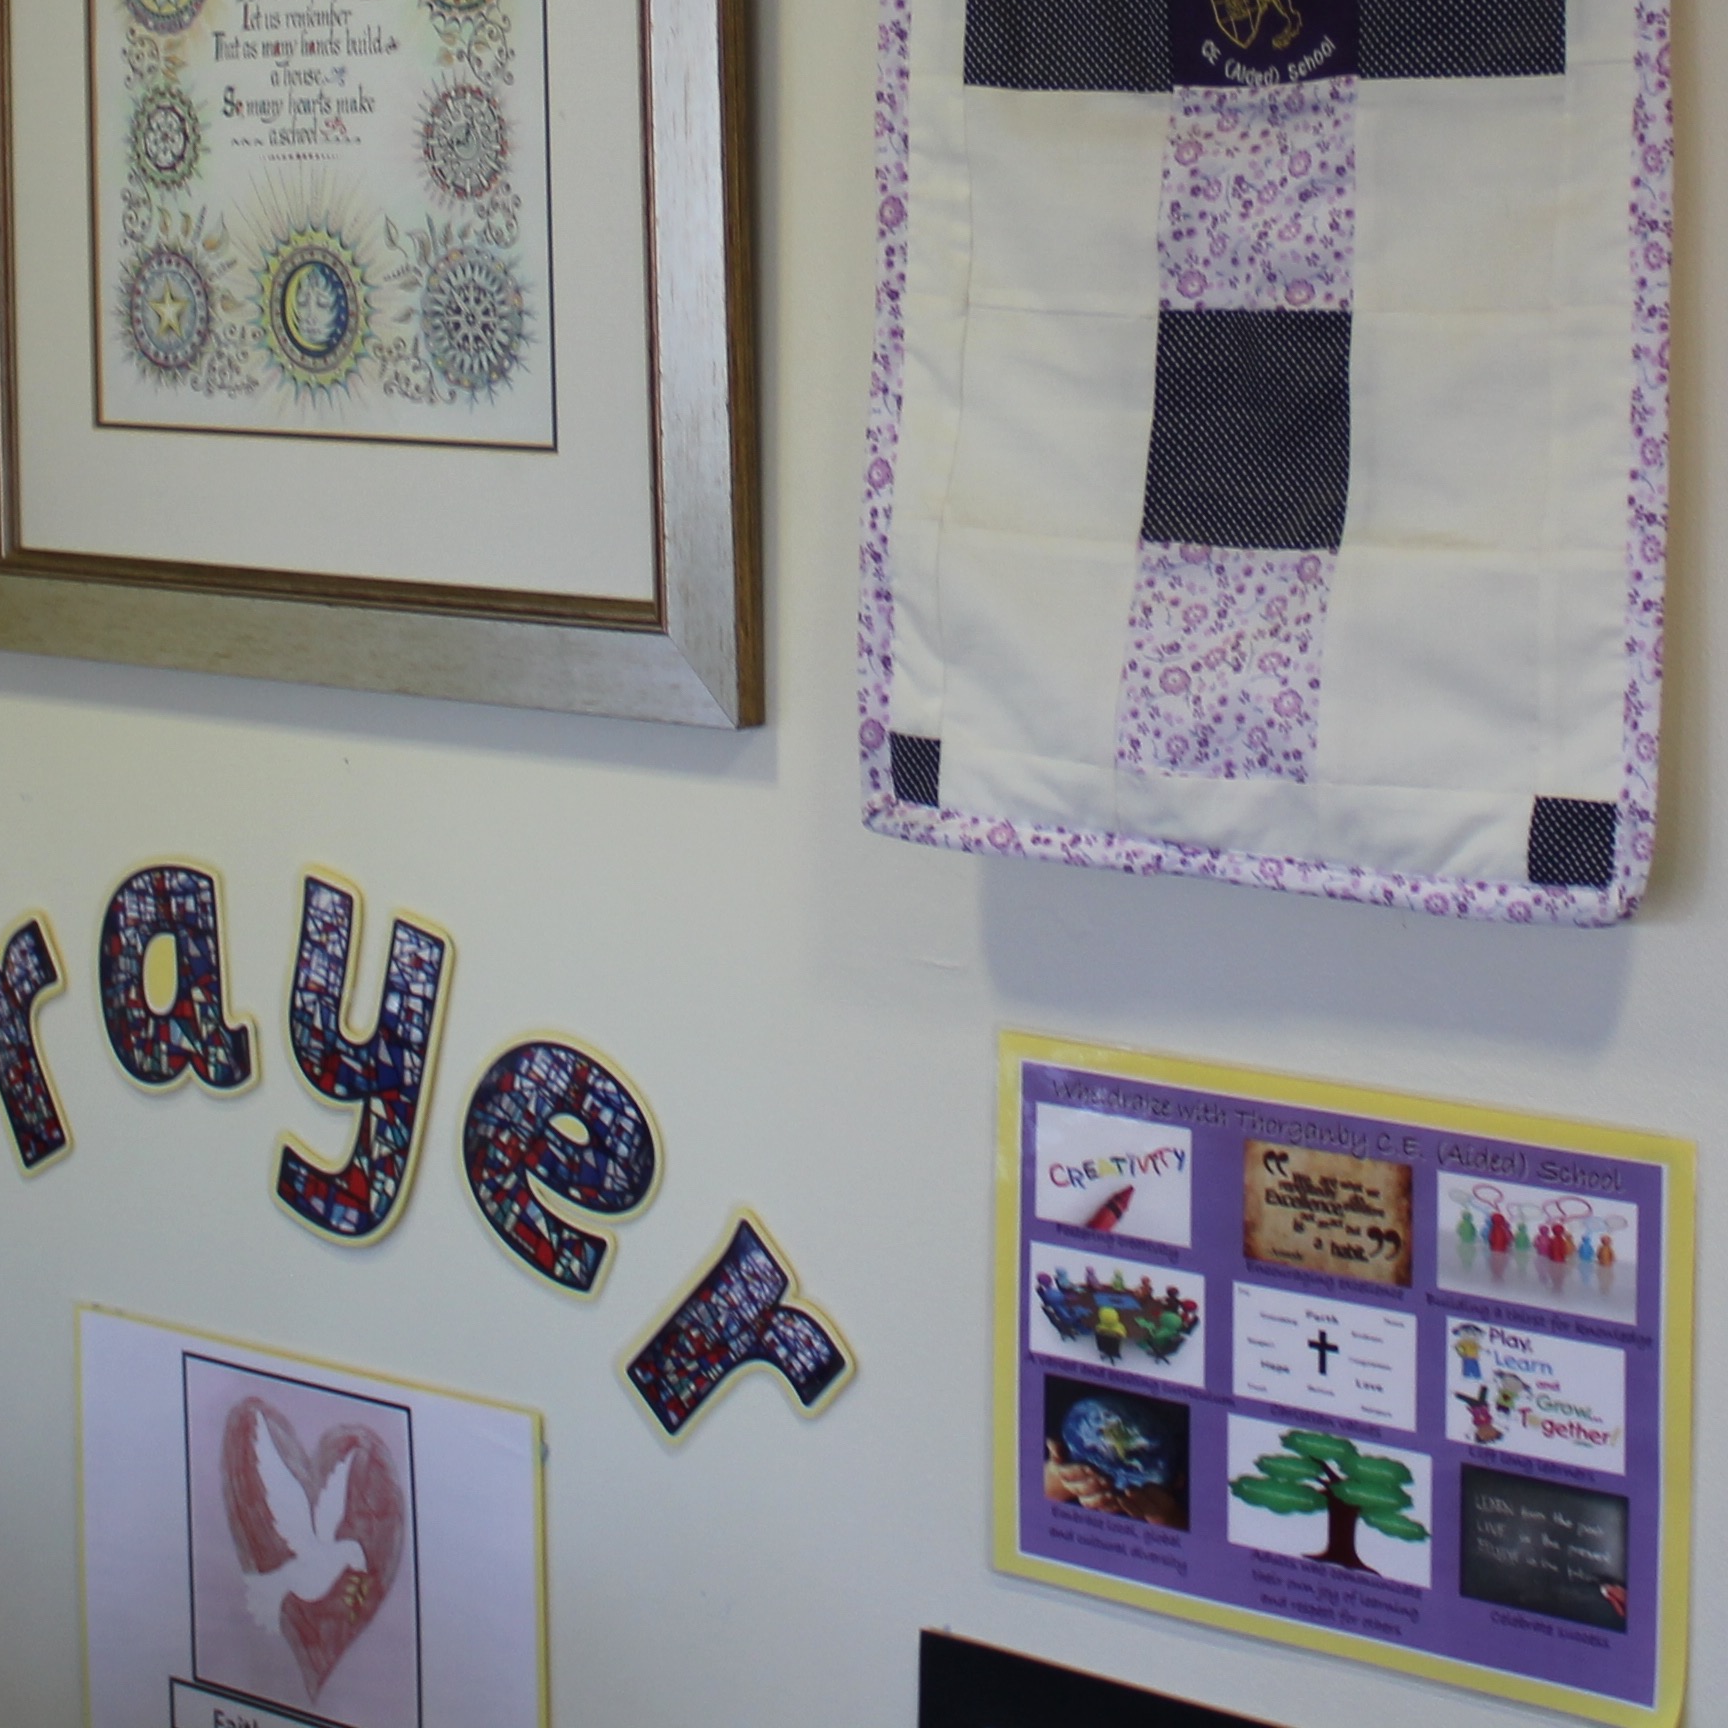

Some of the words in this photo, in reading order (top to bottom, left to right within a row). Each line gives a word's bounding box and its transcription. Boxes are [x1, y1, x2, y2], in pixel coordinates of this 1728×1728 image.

[1287, 34, 1337, 82] School
[1176, 1102, 1227, 1131] with
[1235, 1110, 1366, 1160] Thorganby
[1436, 1138, 1530, 1177] (Aided)
[1536, 1159, 1625, 1194] School
[1493, 1349, 1554, 1377] Learn
